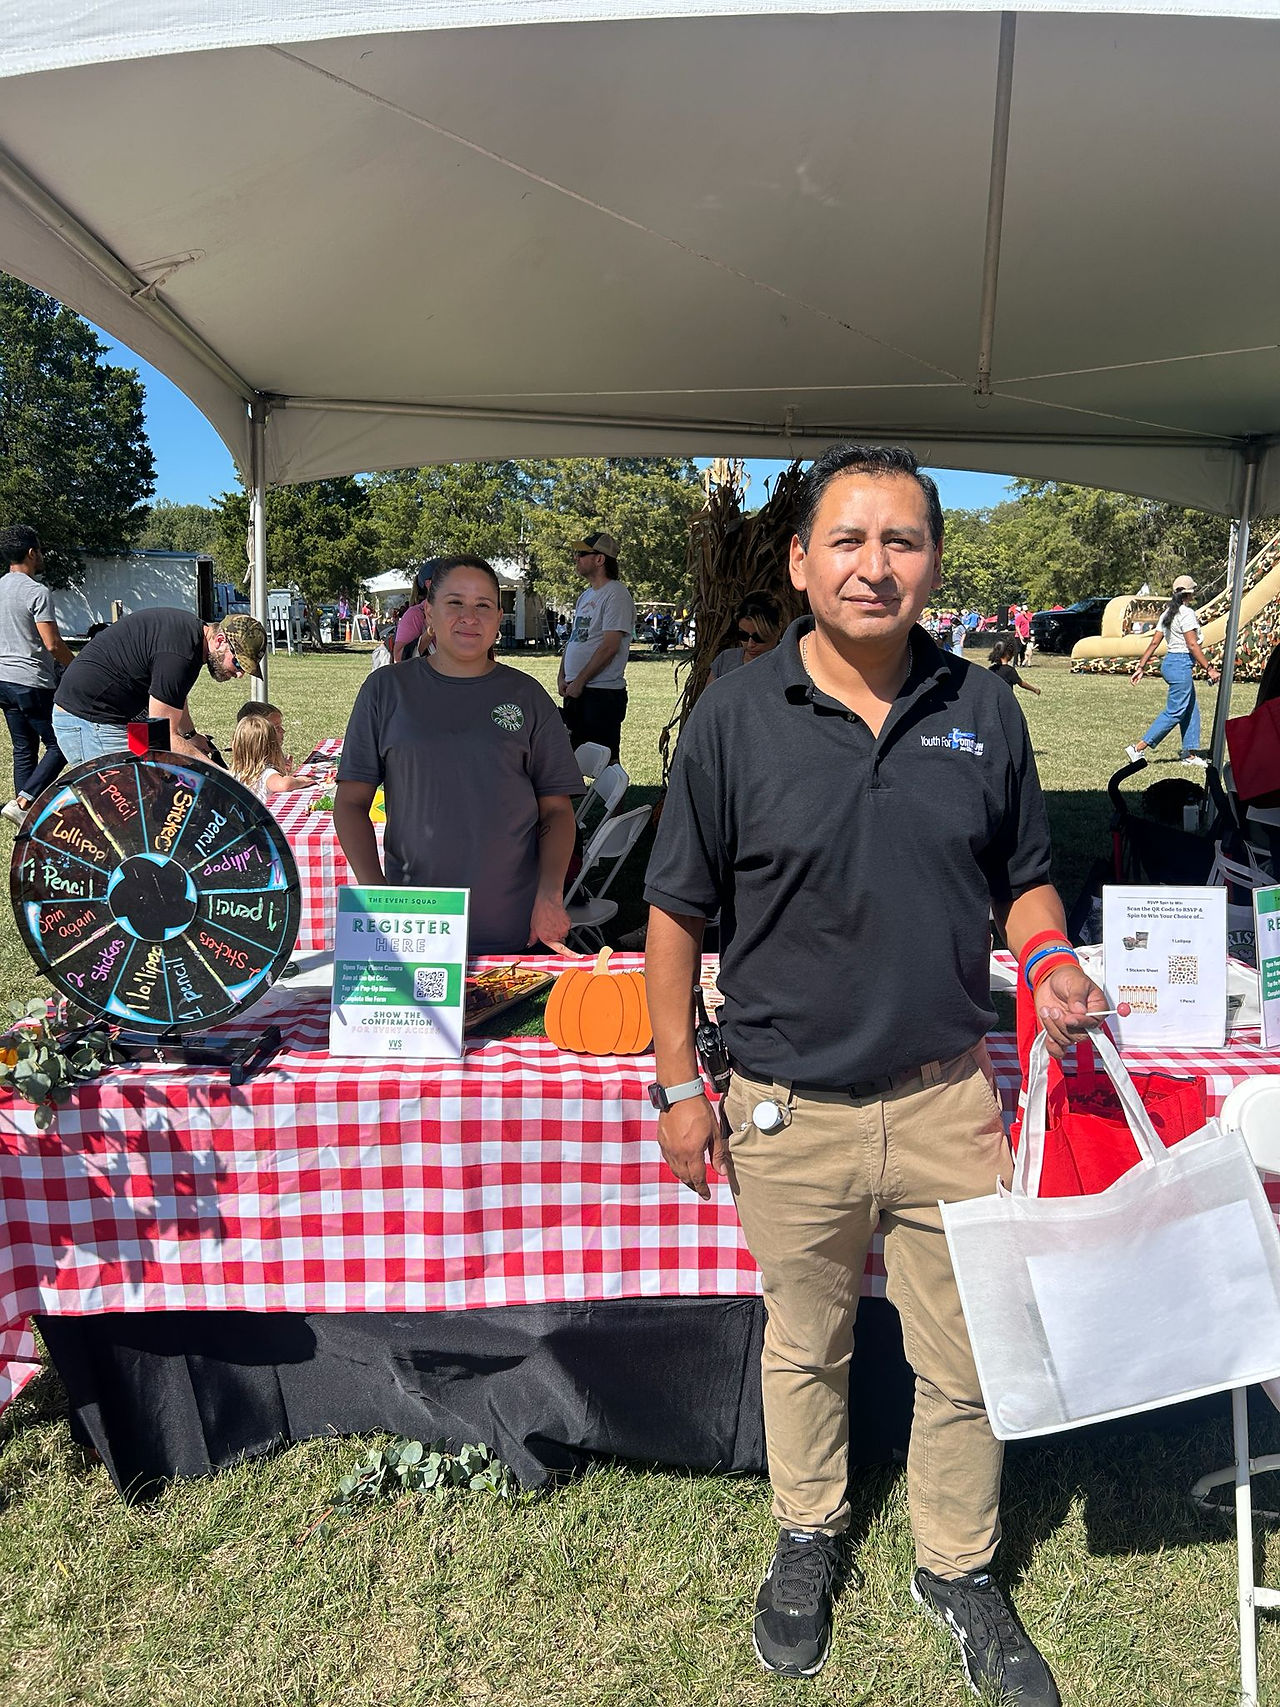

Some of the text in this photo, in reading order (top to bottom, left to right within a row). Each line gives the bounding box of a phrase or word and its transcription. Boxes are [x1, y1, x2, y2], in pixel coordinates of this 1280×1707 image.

[920, 736, 940, 747] Youth
[941, 737, 951, 748] For
[97, 770, 120, 783] 1
[175, 774, 196, 788] 2
[195, 804, 245, 858] 1 pencil
[23, 858, 36, 882] 1
[38, 908, 66, 934] Spin
[58, 910, 96, 938] again
[208, 894, 278, 932] 1 pencil
[352, 918, 450, 934] REGISTER
[200, 932, 248, 969] Stickers
[375, 938, 426, 953] HERE
[66, 972, 86, 988] 2
[164, 957, 204, 1019] 1 pencil
